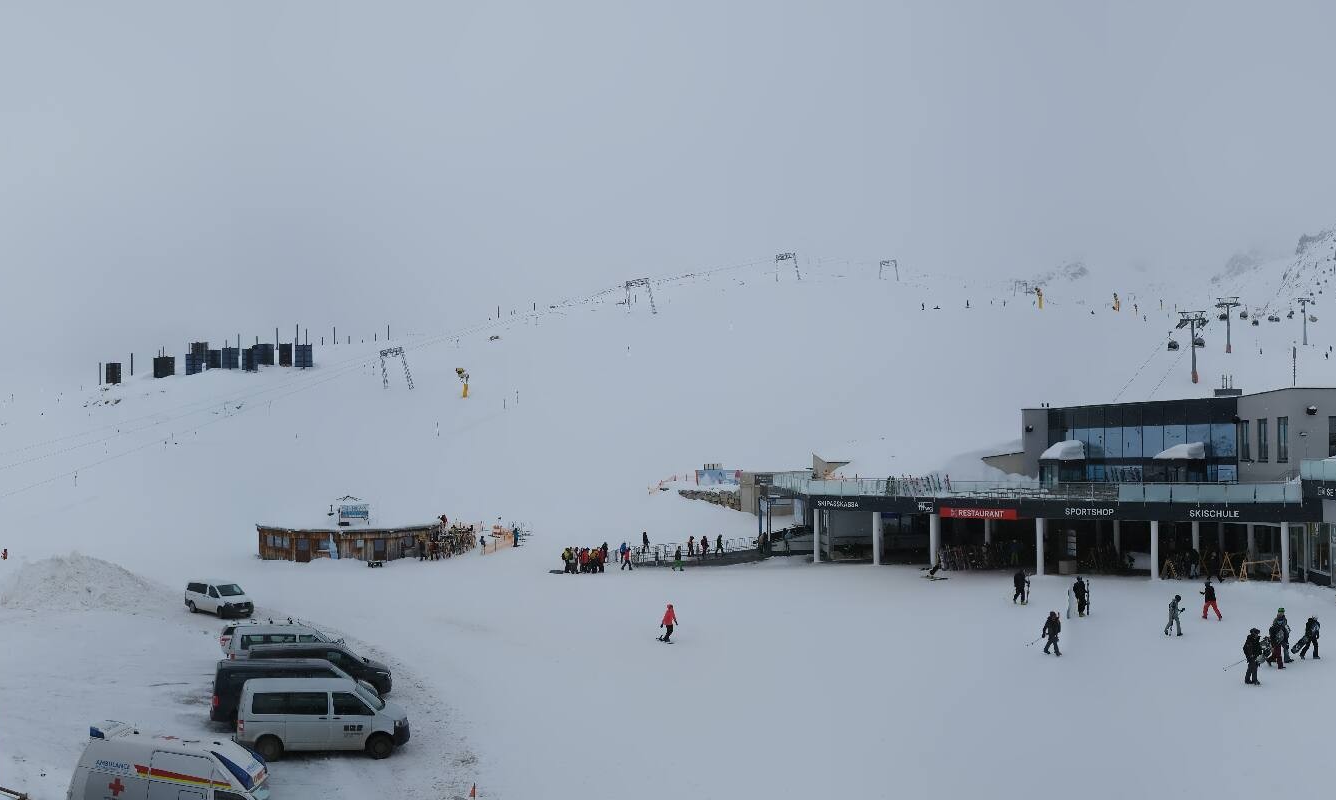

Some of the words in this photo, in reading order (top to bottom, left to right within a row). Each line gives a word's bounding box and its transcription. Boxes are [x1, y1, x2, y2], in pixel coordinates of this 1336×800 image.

[958, 509, 1004, 518] RESTAURANT
[1065, 507, 1114, 516] SPORTSHOP
[1189, 509, 1240, 518] SKISCHULE
